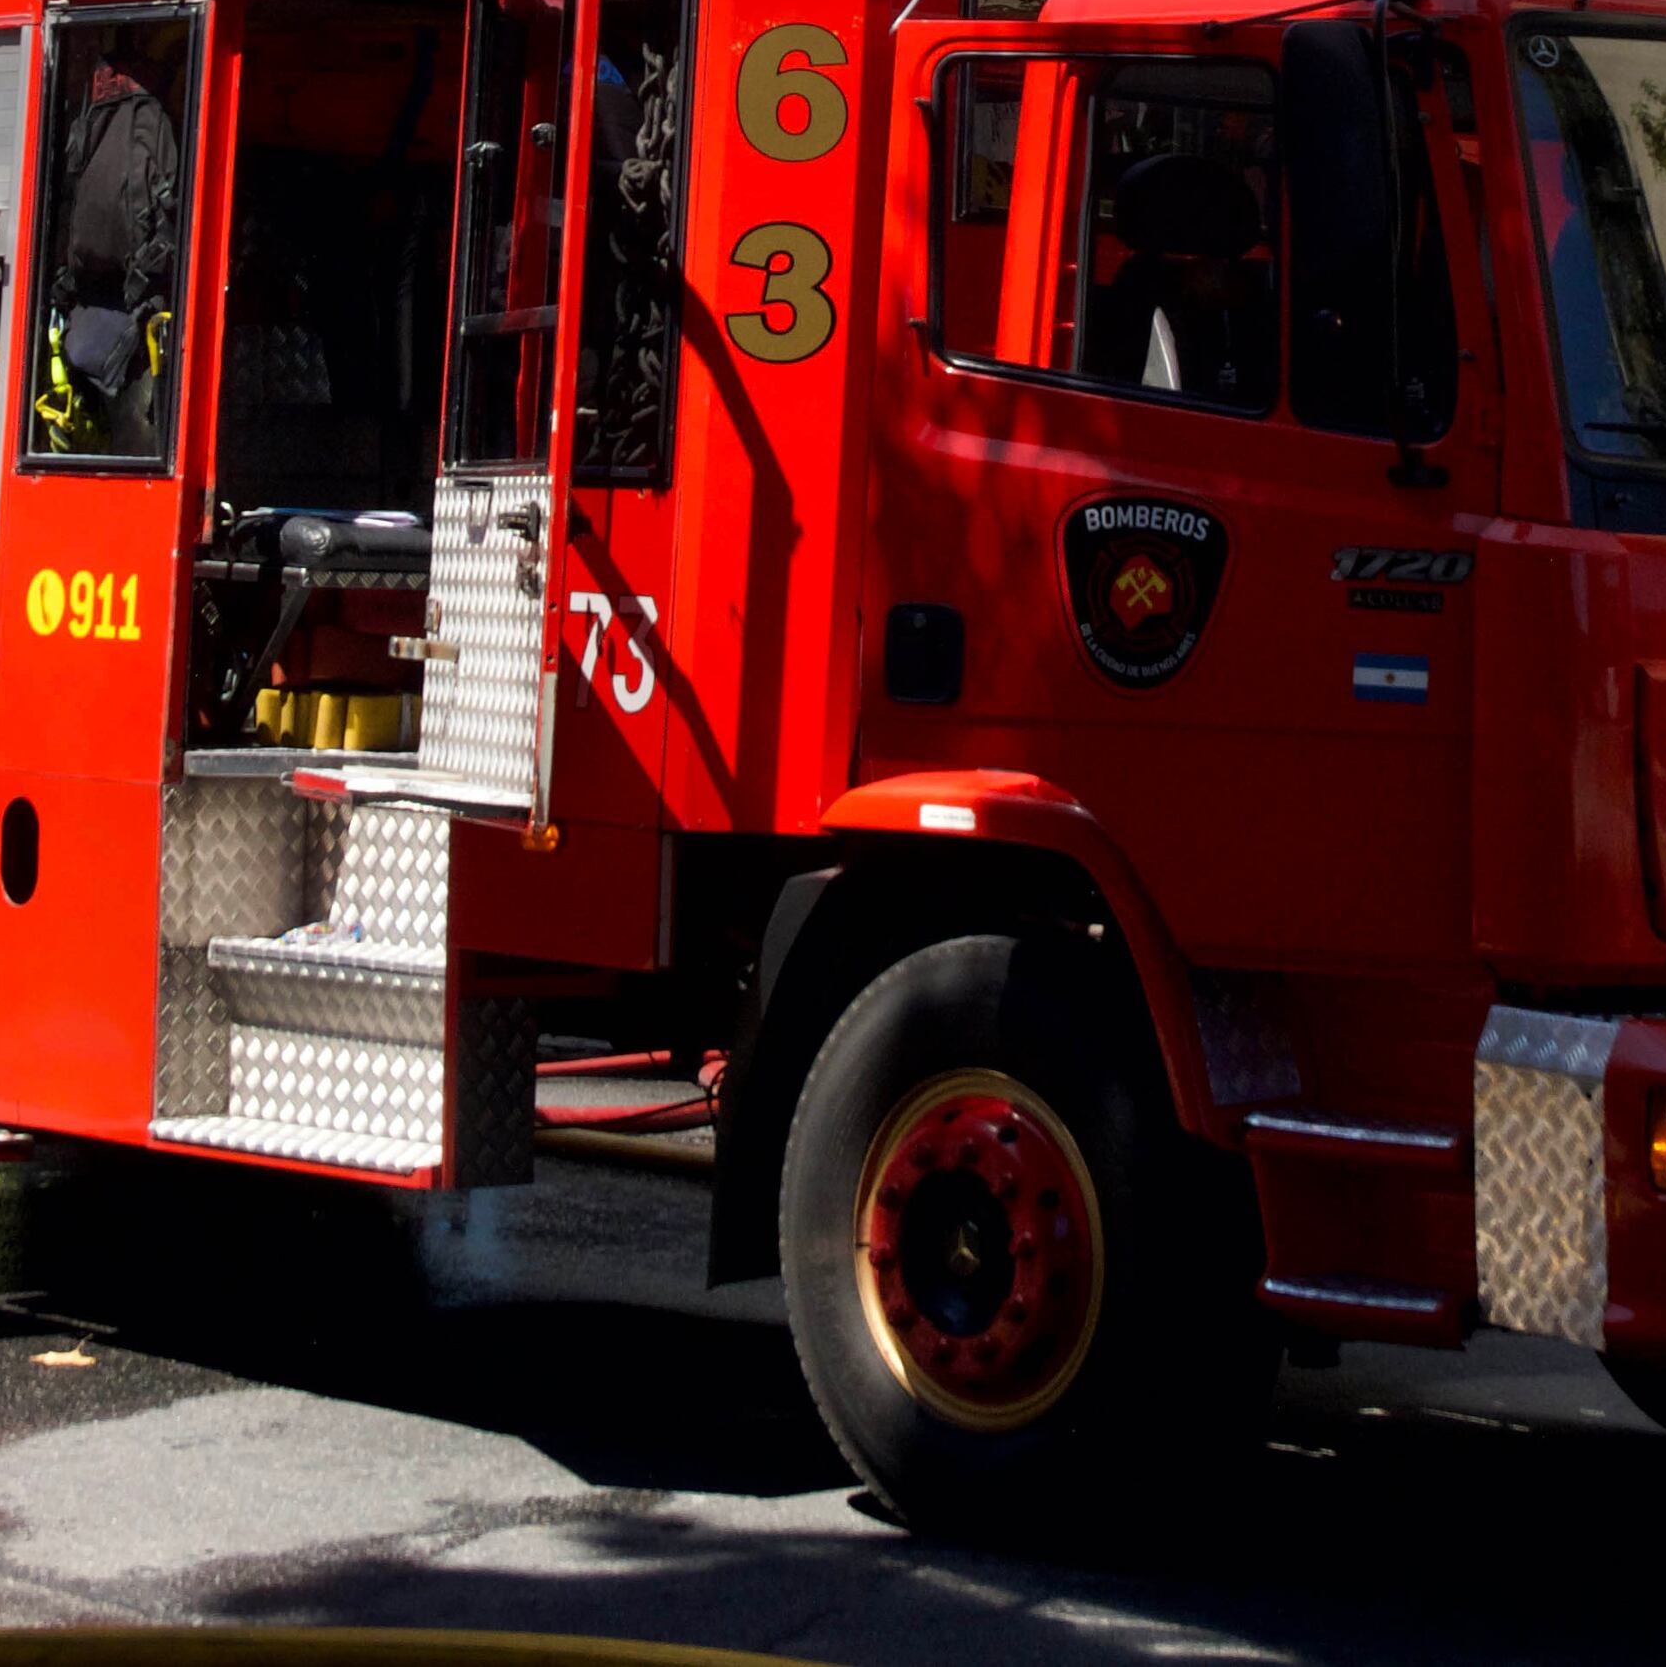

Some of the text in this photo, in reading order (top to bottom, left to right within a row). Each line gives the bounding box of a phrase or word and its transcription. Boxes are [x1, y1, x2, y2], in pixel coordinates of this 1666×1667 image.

[1084, 505, 1210, 541] BOMBEROS
[1331, 547, 1473, 582] 1720
[68, 569, 141, 640] 911
[568, 590, 659, 714] 73
